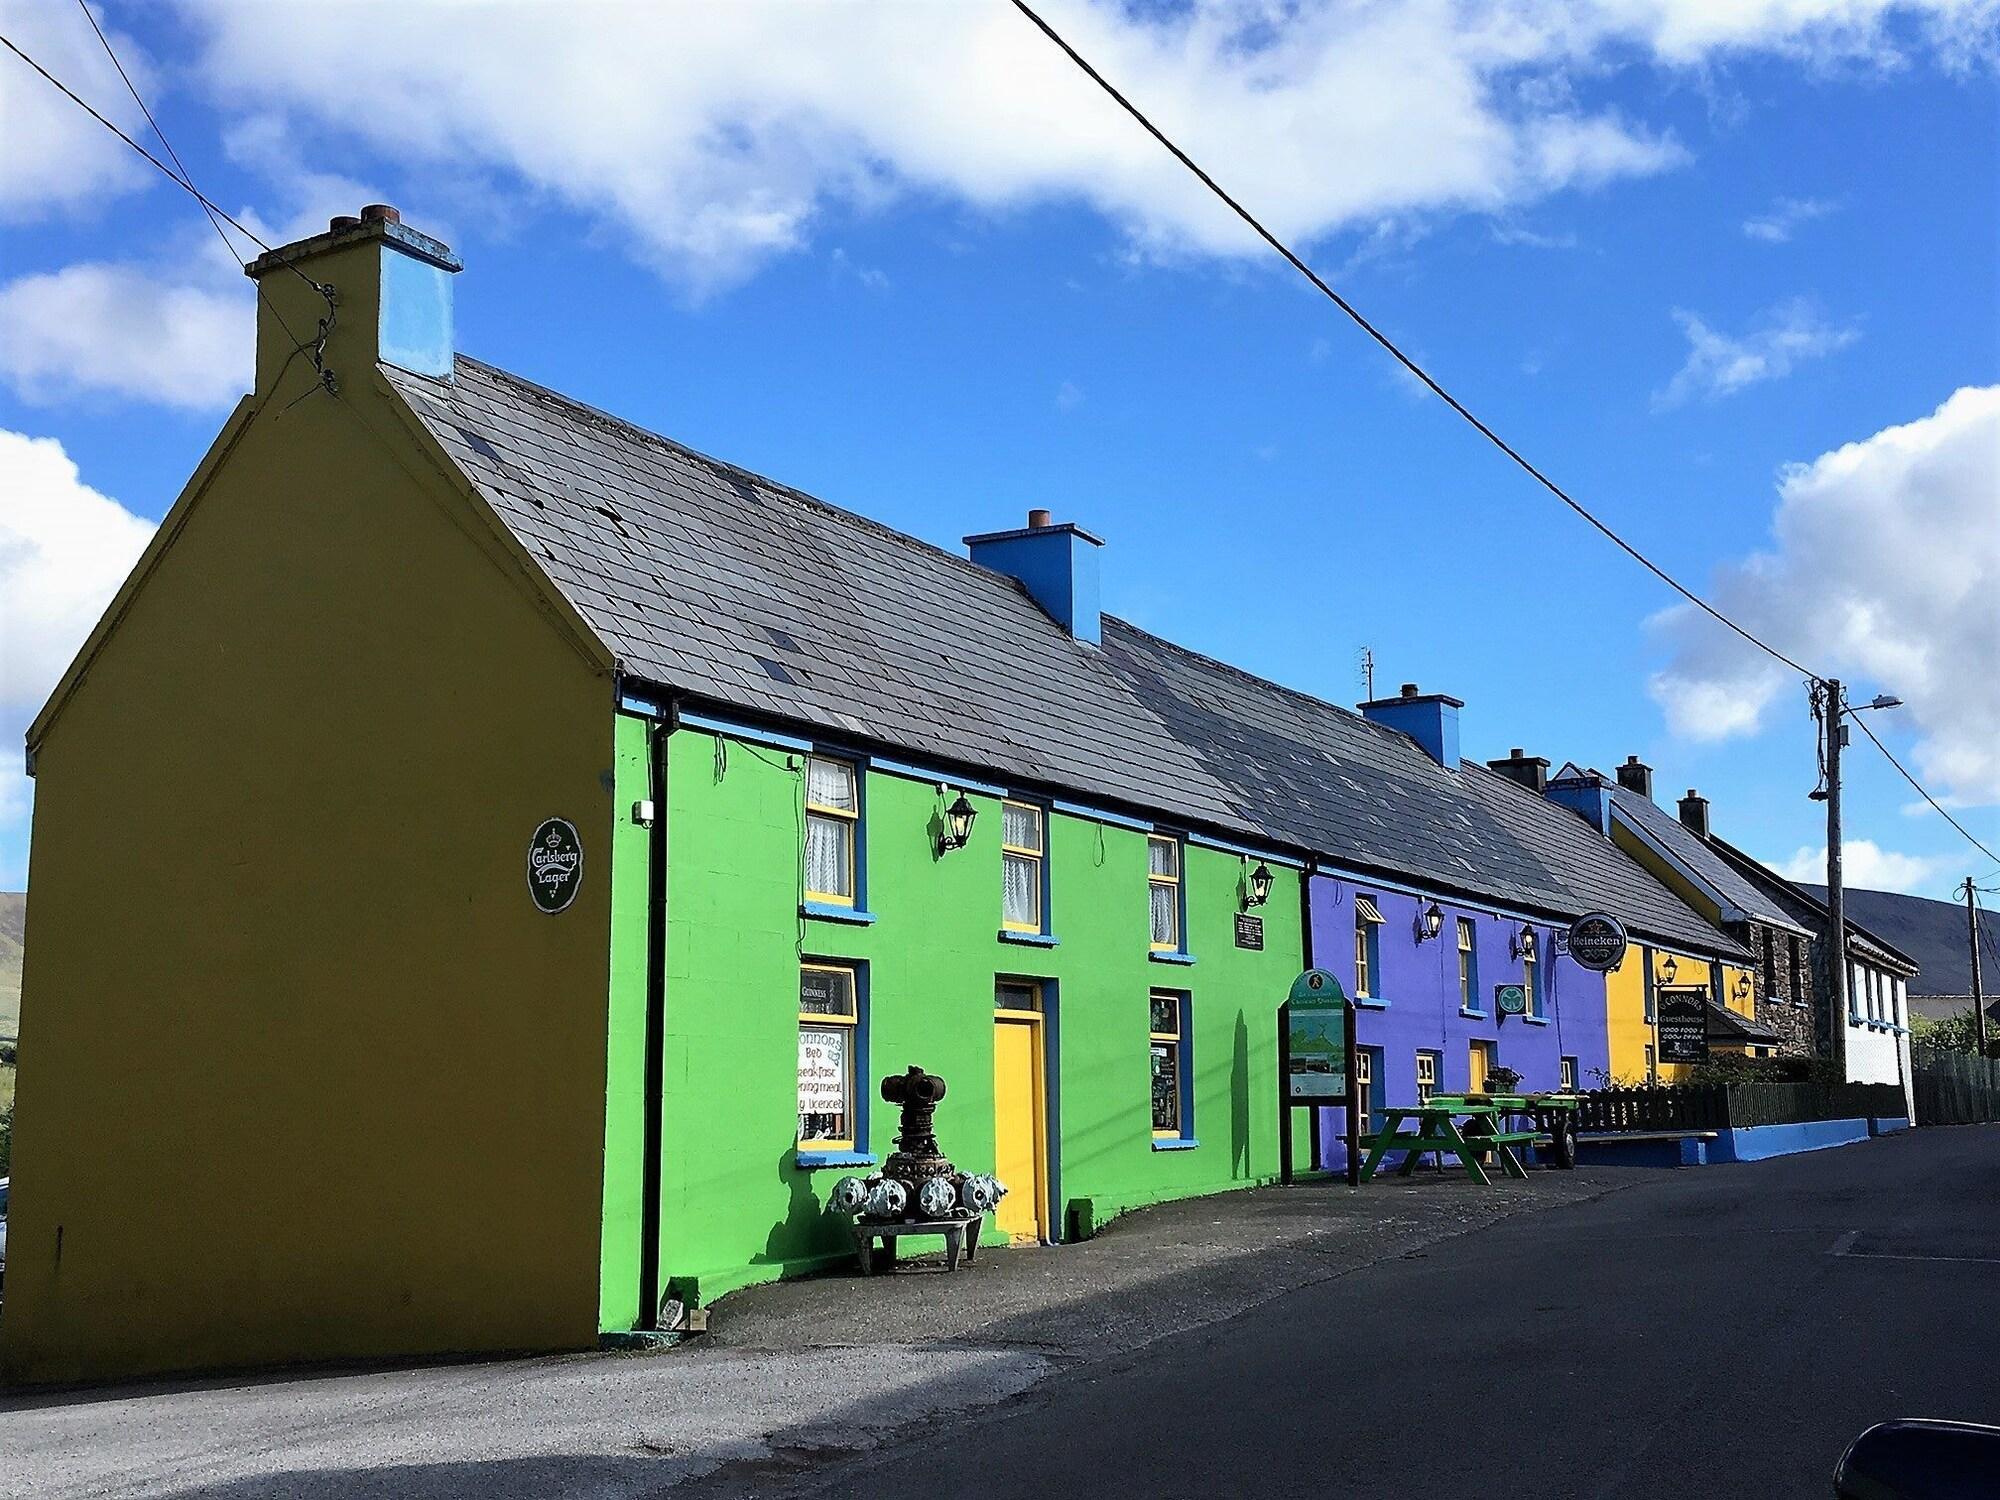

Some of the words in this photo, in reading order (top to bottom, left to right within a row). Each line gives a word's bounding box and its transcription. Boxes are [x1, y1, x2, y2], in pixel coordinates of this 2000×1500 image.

[532, 847, 577, 869] Carlsberg
[538, 871, 570, 890] Lager
[1573, 936, 1621, 946] Heineken
[1659, 1015, 1705, 1024] Guesthouse
